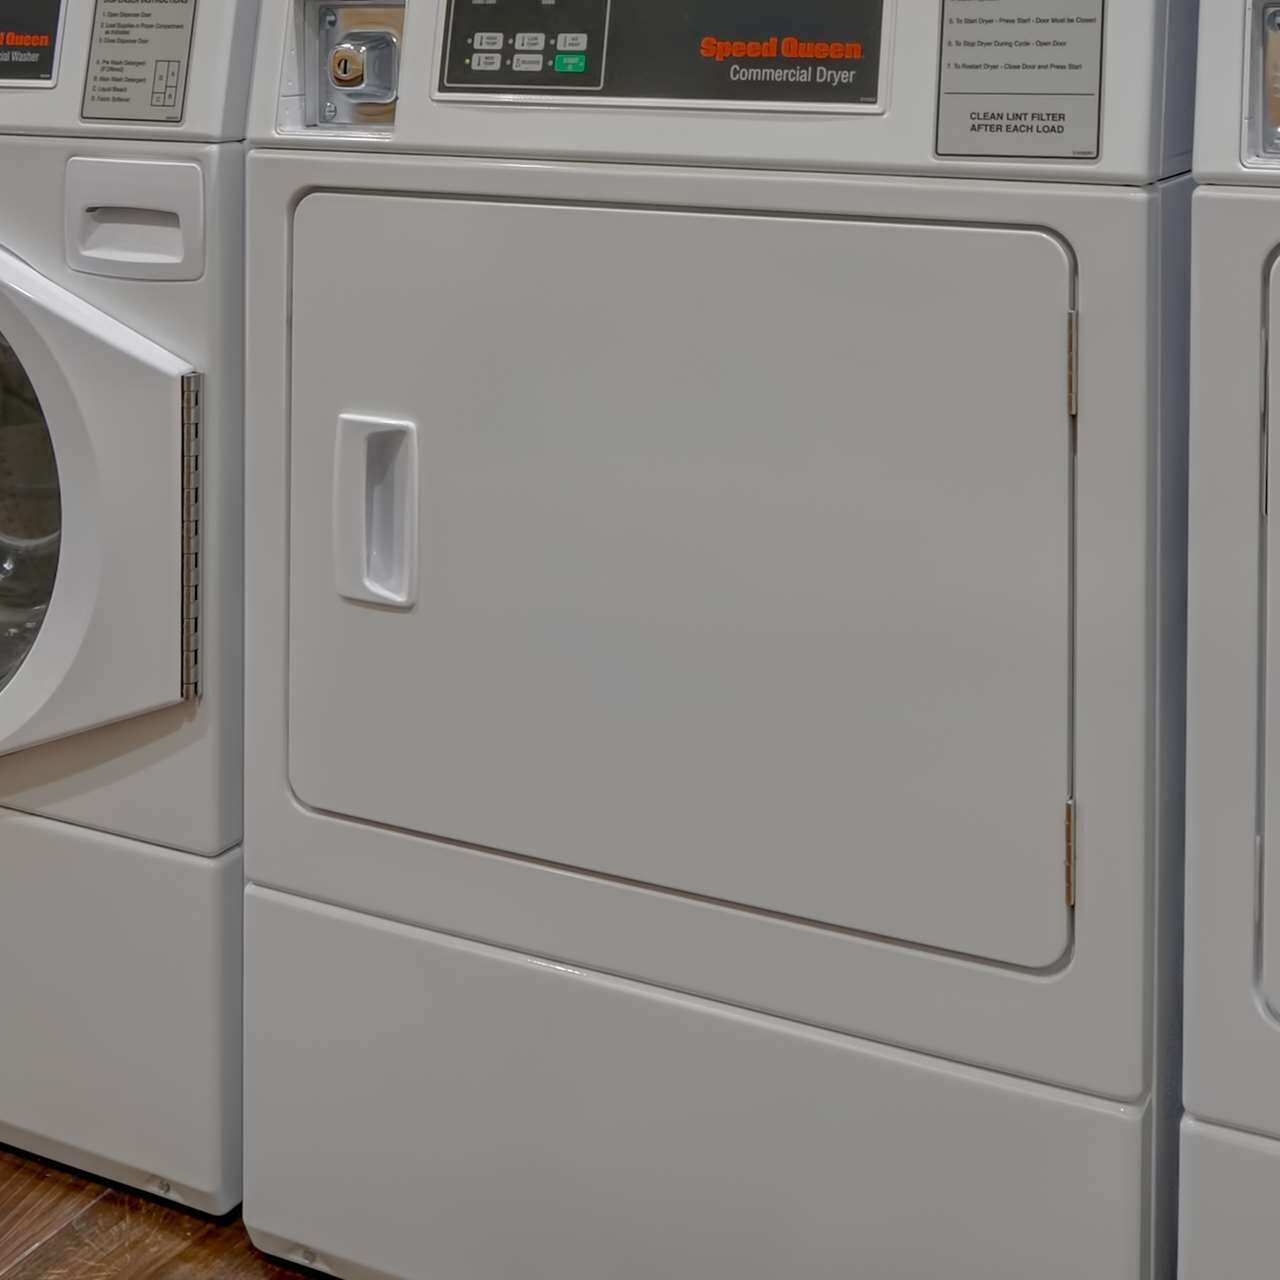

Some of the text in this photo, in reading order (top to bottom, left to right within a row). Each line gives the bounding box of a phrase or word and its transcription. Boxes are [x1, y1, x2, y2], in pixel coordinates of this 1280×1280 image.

[6, 32, 49, 46] Queen
[700, 37, 862, 61] Speed Queen
[12, 51, 39, 62] Washer
[730, 65, 856, 86] Commercial Dryer
[970, 112, 1065, 121] CLEAN LINT FILTER
[970, 124, 1064, 134] AFTER EACH LOAD
